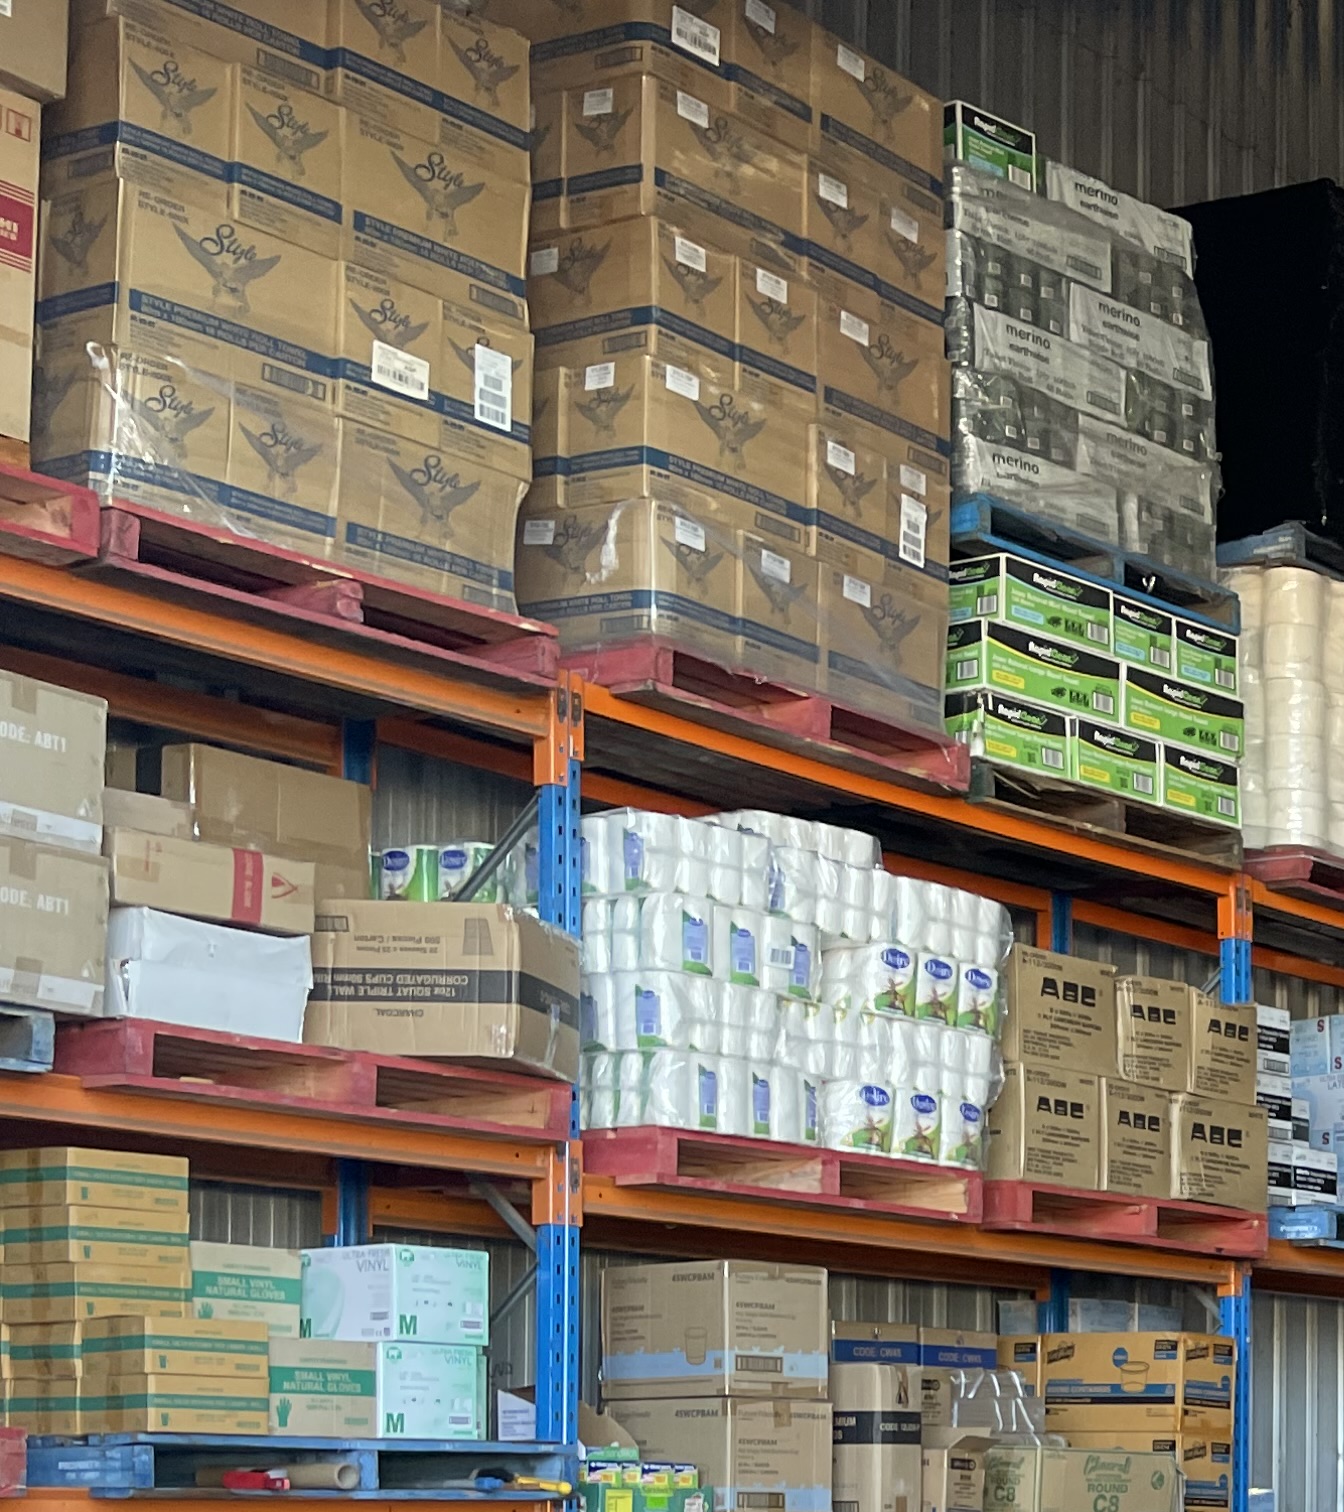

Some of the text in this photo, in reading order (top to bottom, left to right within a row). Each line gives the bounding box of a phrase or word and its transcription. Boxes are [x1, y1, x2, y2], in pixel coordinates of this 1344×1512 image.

[151, 60, 197, 93] Style
[266, 104, 310, 136] Style
[414, 152, 464, 189] Style
[1074, 181, 1118, 206] merino
[200, 224, 257, 264] Style
[368, 298, 410, 331] Style
[1098, 301, 1141, 328] merino
[1006, 323, 1051, 350] merino
[144, 385, 195, 417] Style
[410, 455, 461, 491] Style
[992, 450, 1040, 475] merino
[1032, 572, 1083, 600] RapidClean
[1029, 641, 1079, 667] RapidClean
[997, 704, 1048, 729] RapidClean
[0, 720, 67, 752] ODE: ABT1
[0, 886, 69, 916] ODE: ABT1
[360, 986, 394, 997] TRIPLE
[366, 974, 393, 985] CUPS
[396, 974, 468, 985] CORRUGATED
[397, 987, 431, 997] SQUAT
[1041, 976, 1096, 1008] ABC
[1131, 1004, 1176, 1025] ABC
[1317, 1019, 1325, 1032] S
[1207, 1018, 1249, 1042] ABC
[1334, 1056, 1342, 1070] S
[1036, 1096, 1084, 1119] ABC
[1117, 1110, 1160, 1132] ABC
[1191, 1122, 1242, 1148] ABC
[357, 1260, 389, 1273] VINYL
[205, 1286, 248, 1298] NATURAL
[217, 1276, 247, 1289] SMALL
[400, 1314, 417, 1335] M
[386, 1413, 405, 1433] M
[994, 1486, 1015, 1502] C8
[1087, 1484, 1128, 1493] ROUND
